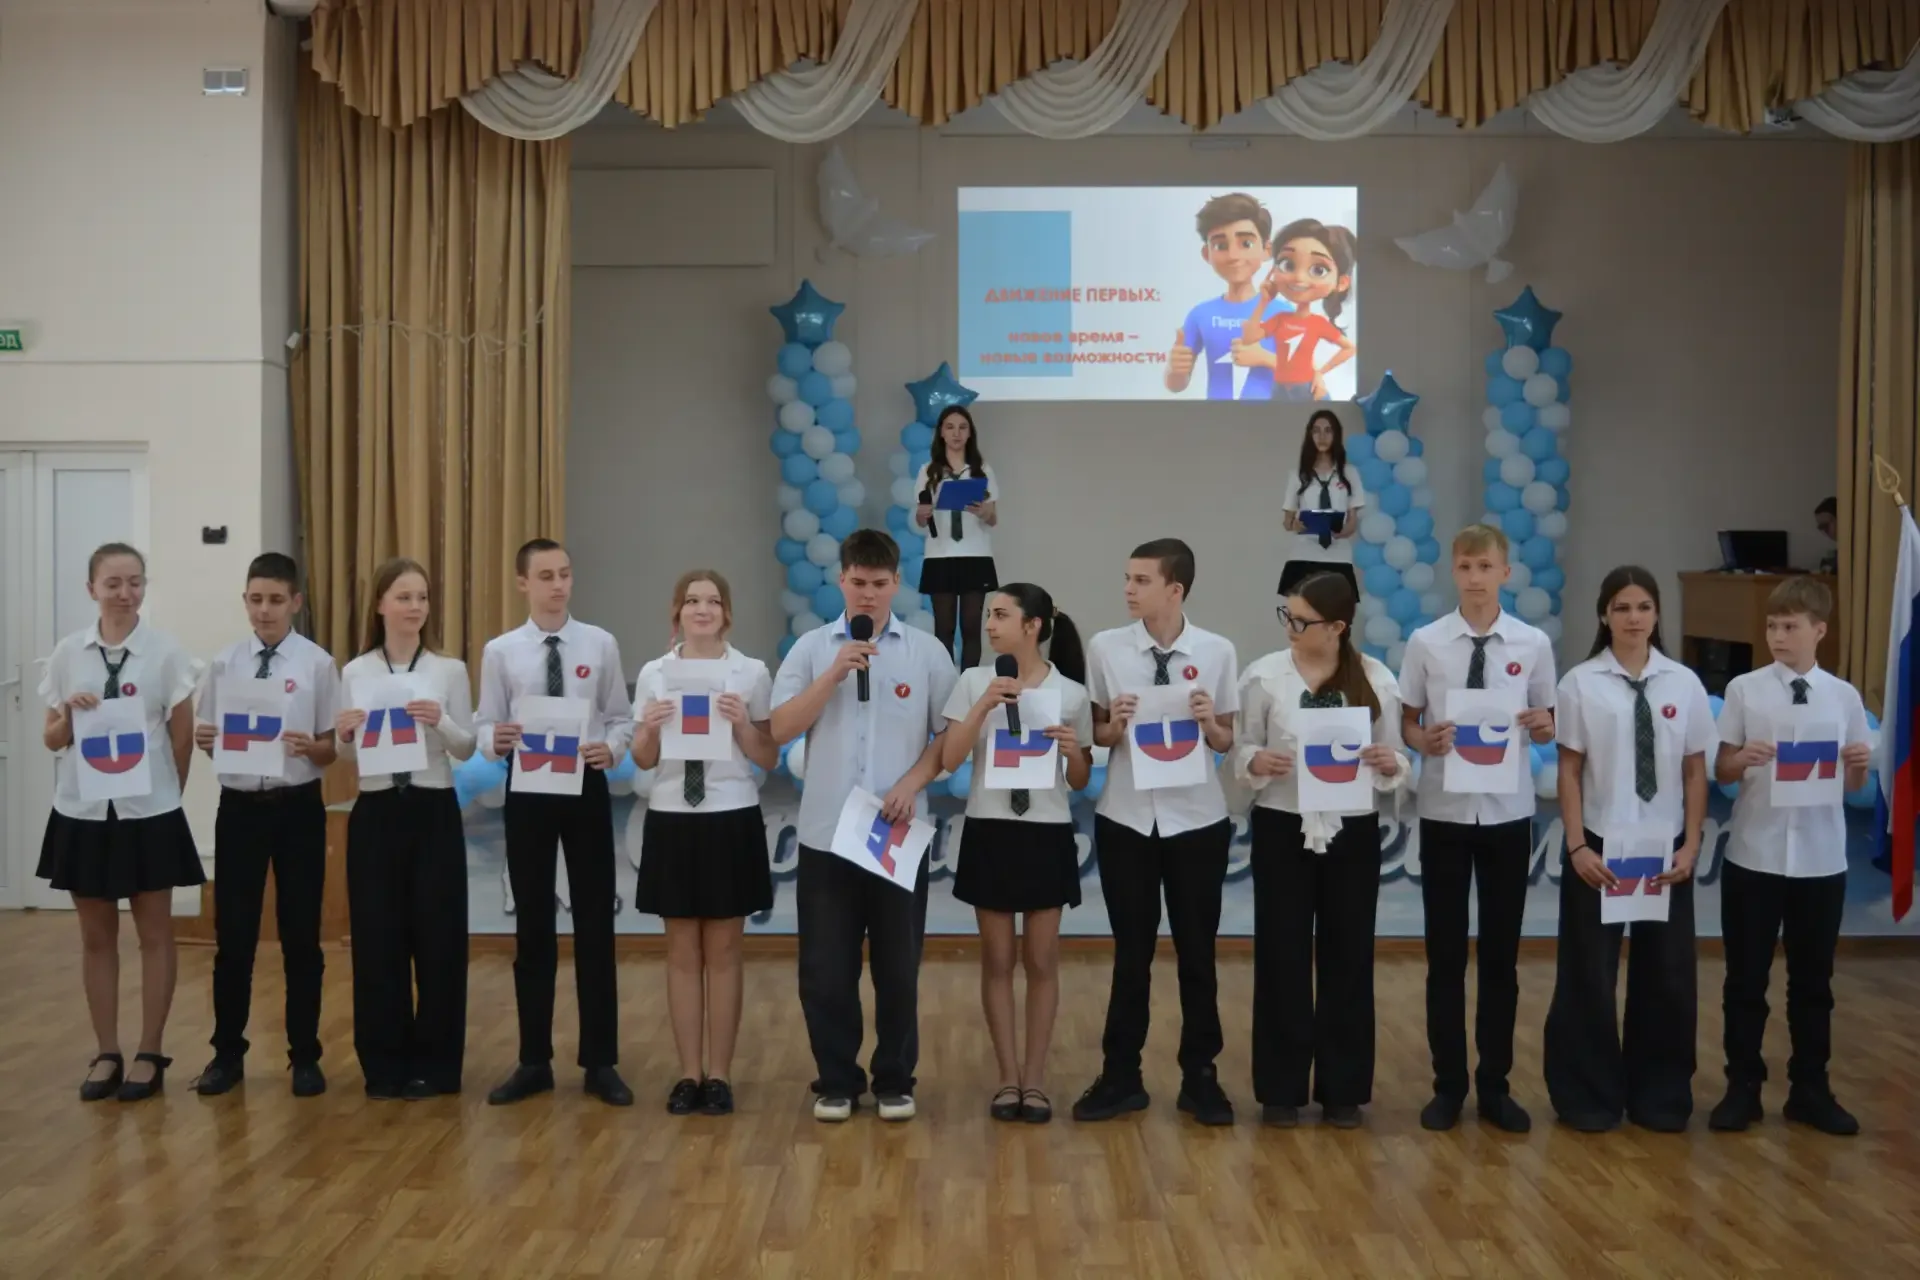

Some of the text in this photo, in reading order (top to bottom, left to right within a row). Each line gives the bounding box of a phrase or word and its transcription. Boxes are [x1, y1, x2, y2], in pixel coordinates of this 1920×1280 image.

[984, 287, 1161, 303] ДВИЖЕНИЕ ПЕРВЫХ:
[1008, 331, 1063, 344] новое
[1069, 331, 1125, 346] время
[979, 352, 1167, 365] новые возможности
